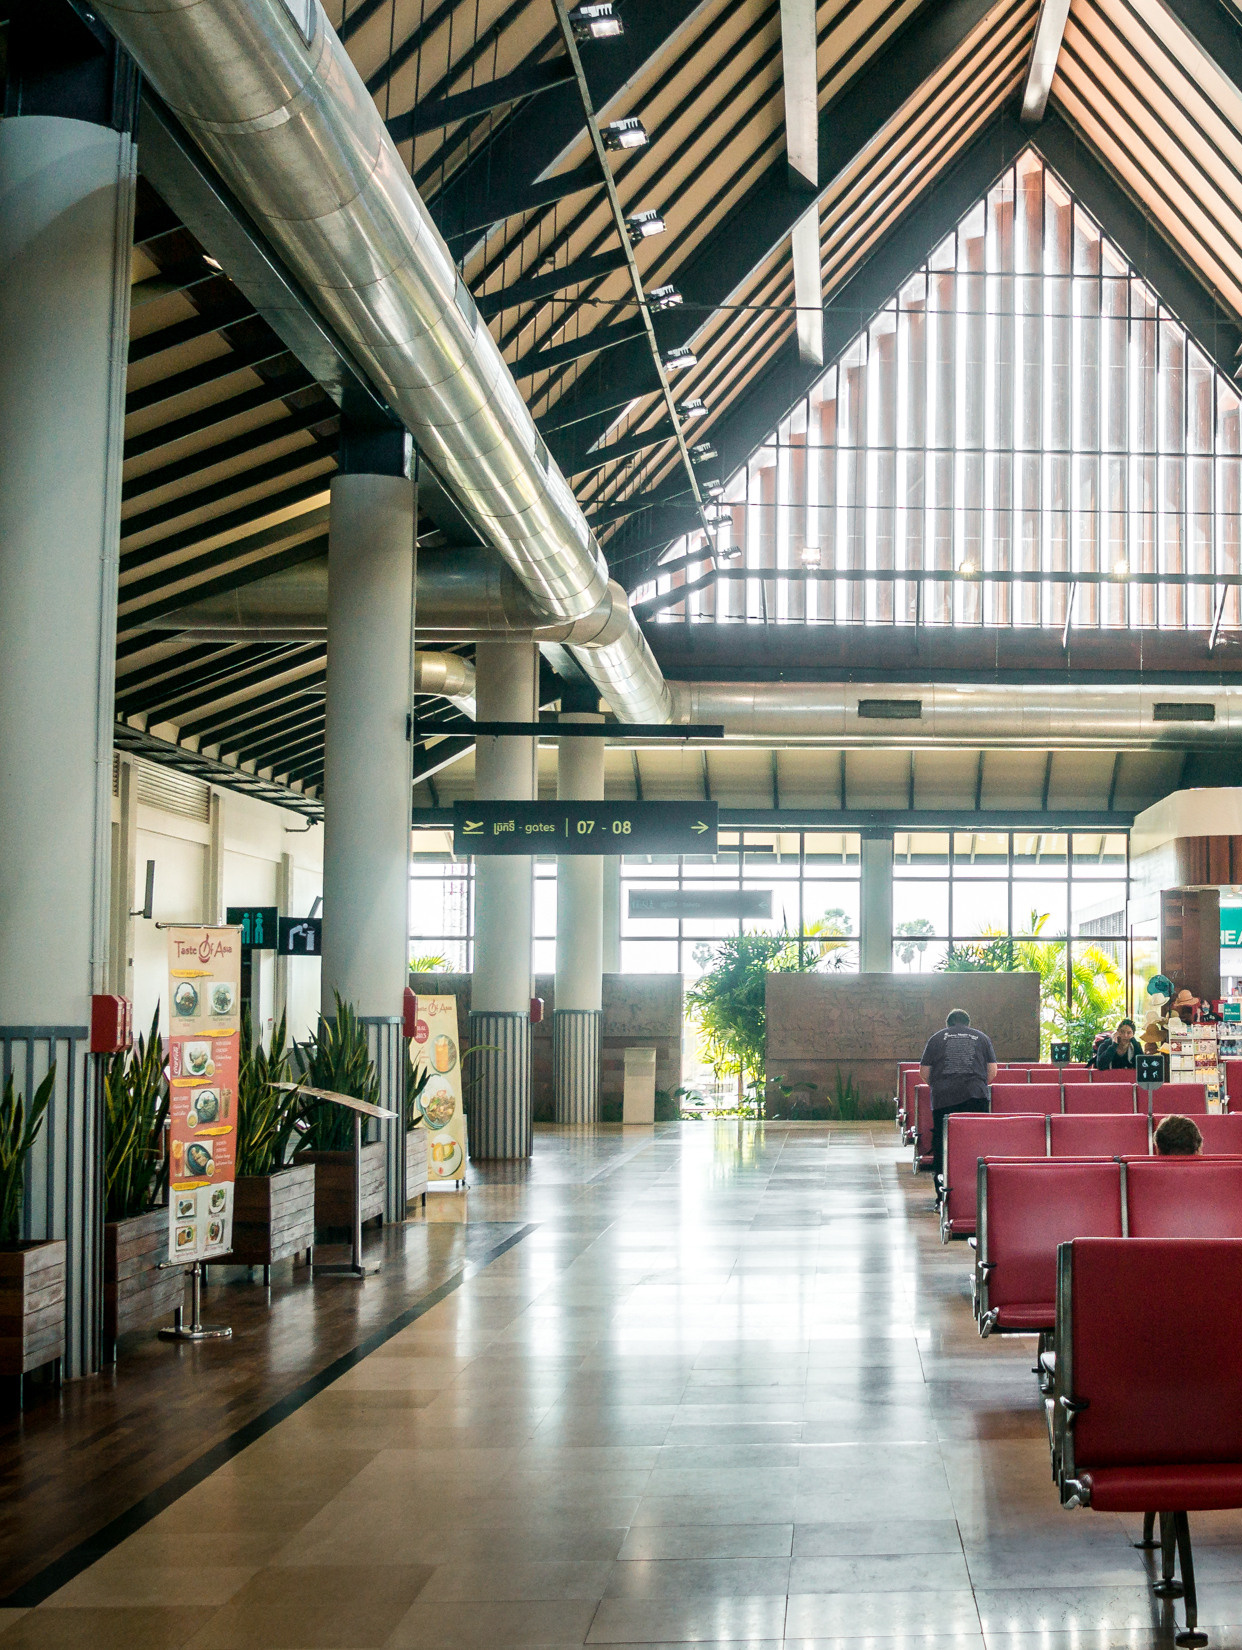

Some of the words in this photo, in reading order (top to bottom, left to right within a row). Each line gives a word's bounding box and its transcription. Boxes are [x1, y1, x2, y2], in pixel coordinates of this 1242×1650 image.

[525, 824, 555, 835] gates
[577, 821, 595, 834] 07
[612, 821, 632, 834] 08
[174, 940, 197, 958] Taste
[214, 940, 232, 958] Asia
